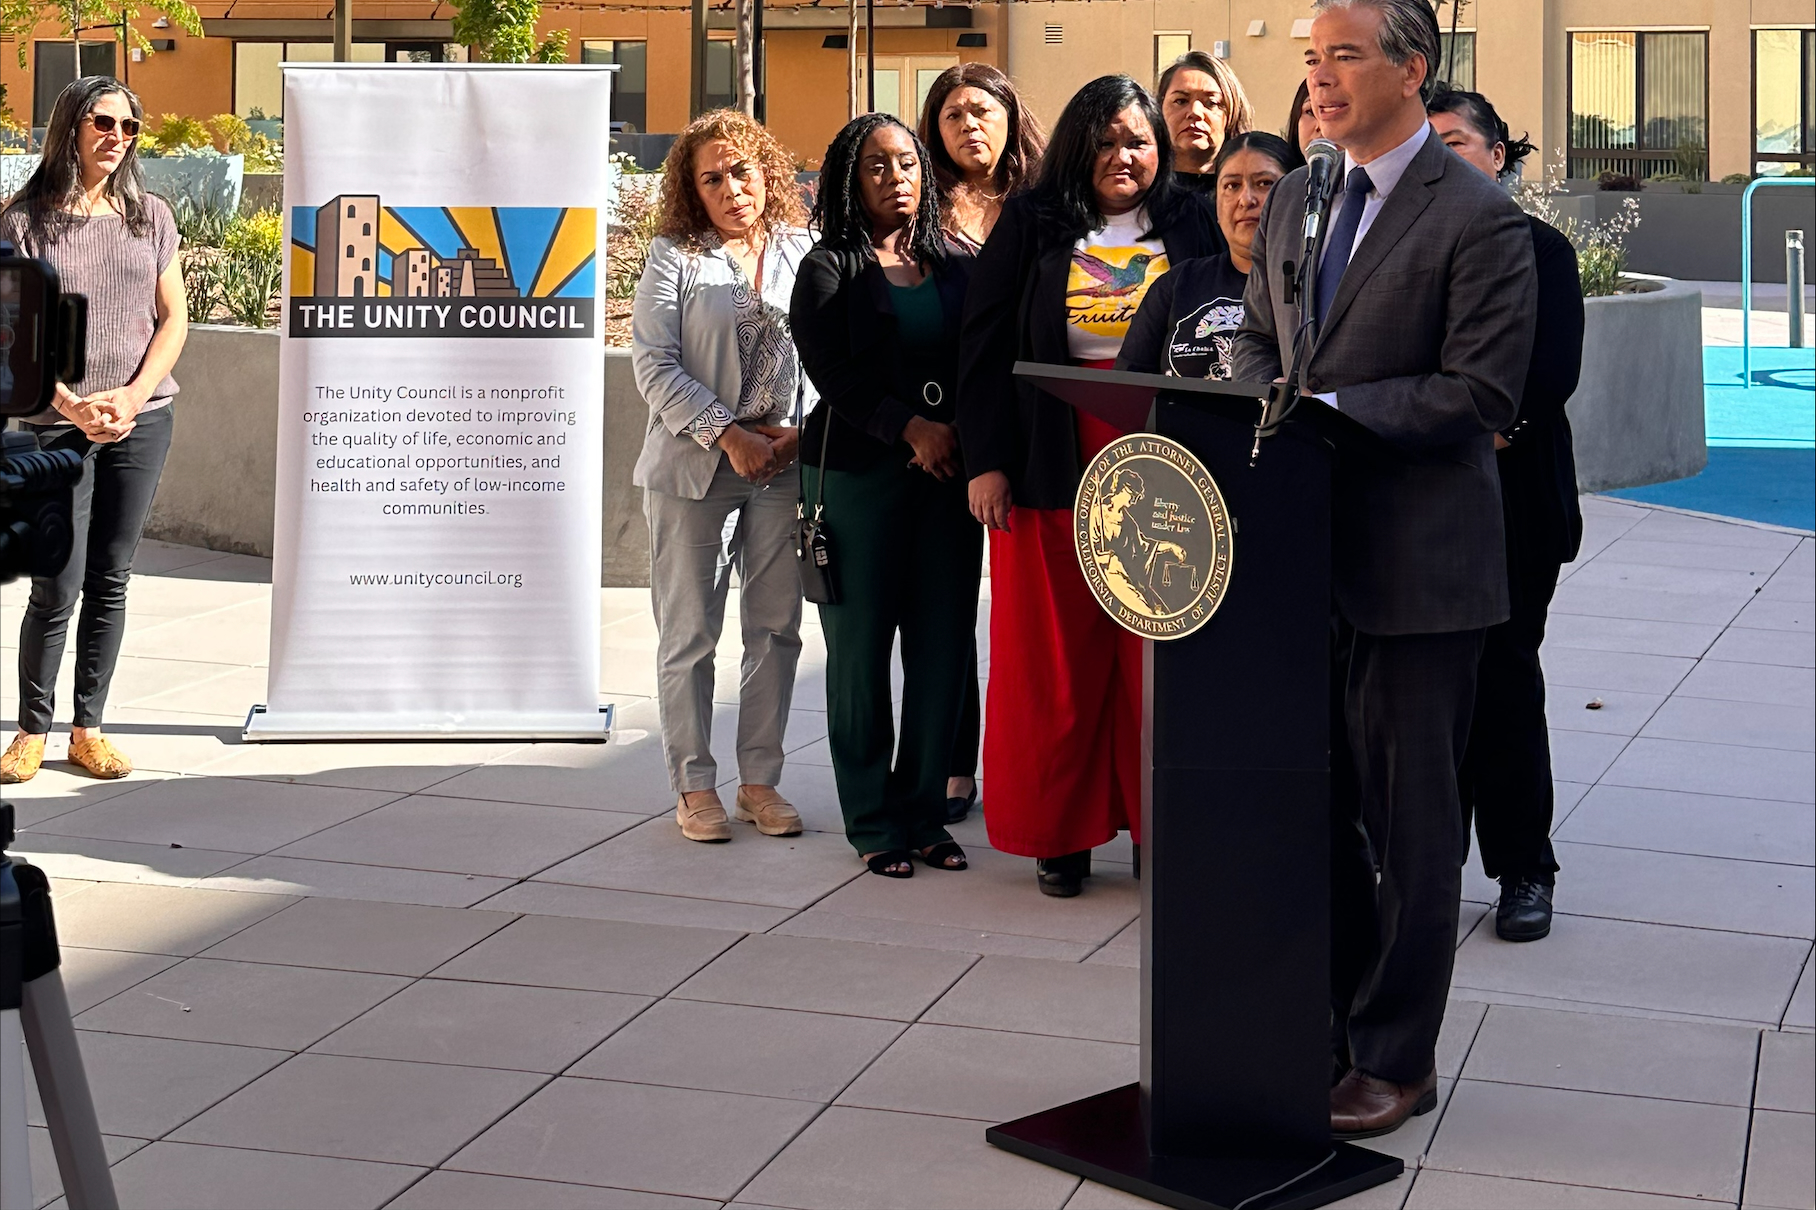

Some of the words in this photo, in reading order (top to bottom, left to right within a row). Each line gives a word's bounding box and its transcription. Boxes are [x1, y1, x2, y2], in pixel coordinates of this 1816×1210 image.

[298, 304, 355, 329] THE
[364, 304, 452, 329] UNITY
[459, 304, 586, 330] COUNCIL
[314, 385, 346, 400] The
[350, 385, 393, 403] Unity
[396, 385, 457, 400] Council
[461, 385, 473, 400] is
[477, 388, 486, 400] a
[490, 385, 565, 403] nonprofit
[303, 408, 402, 427] organization
[406, 408, 472, 423] devoted
[475, 409, 493, 423] to
[497, 408, 577, 426] improving
[311, 431, 339, 446] the
[342, 431, 398, 450] quality
[402, 430, 421, 446] of
[423, 430, 452, 448] life,
[456, 431, 534, 446] economic
[536, 431, 566, 446] and
[316, 453, 411, 469] educational
[415, 454, 527, 472] opportunities,
[531, 454, 561, 469] and
[310, 477, 361, 493] health
[365, 477, 396, 492] and
[399, 477, 450, 496] safety
[453, 477, 471, 492] of
[474, 477, 566, 492] low-income
[1098, 455, 1112, 472] OF
[1111, 443, 1135, 459] THE
[1139, 440, 1198, 477] ATTORNEY
[1197, 476, 1226, 542] GENERAL
[382, 500, 490, 515] communities.
[349, 570, 523, 589] www.unitycouncil.org
[1078, 530, 1115, 607] CALIFORNIA
[1117, 605, 1188, 633] DEPARTMENT
[1191, 602, 1206, 621] OF
[1204, 551, 1228, 606] JUSTICE
